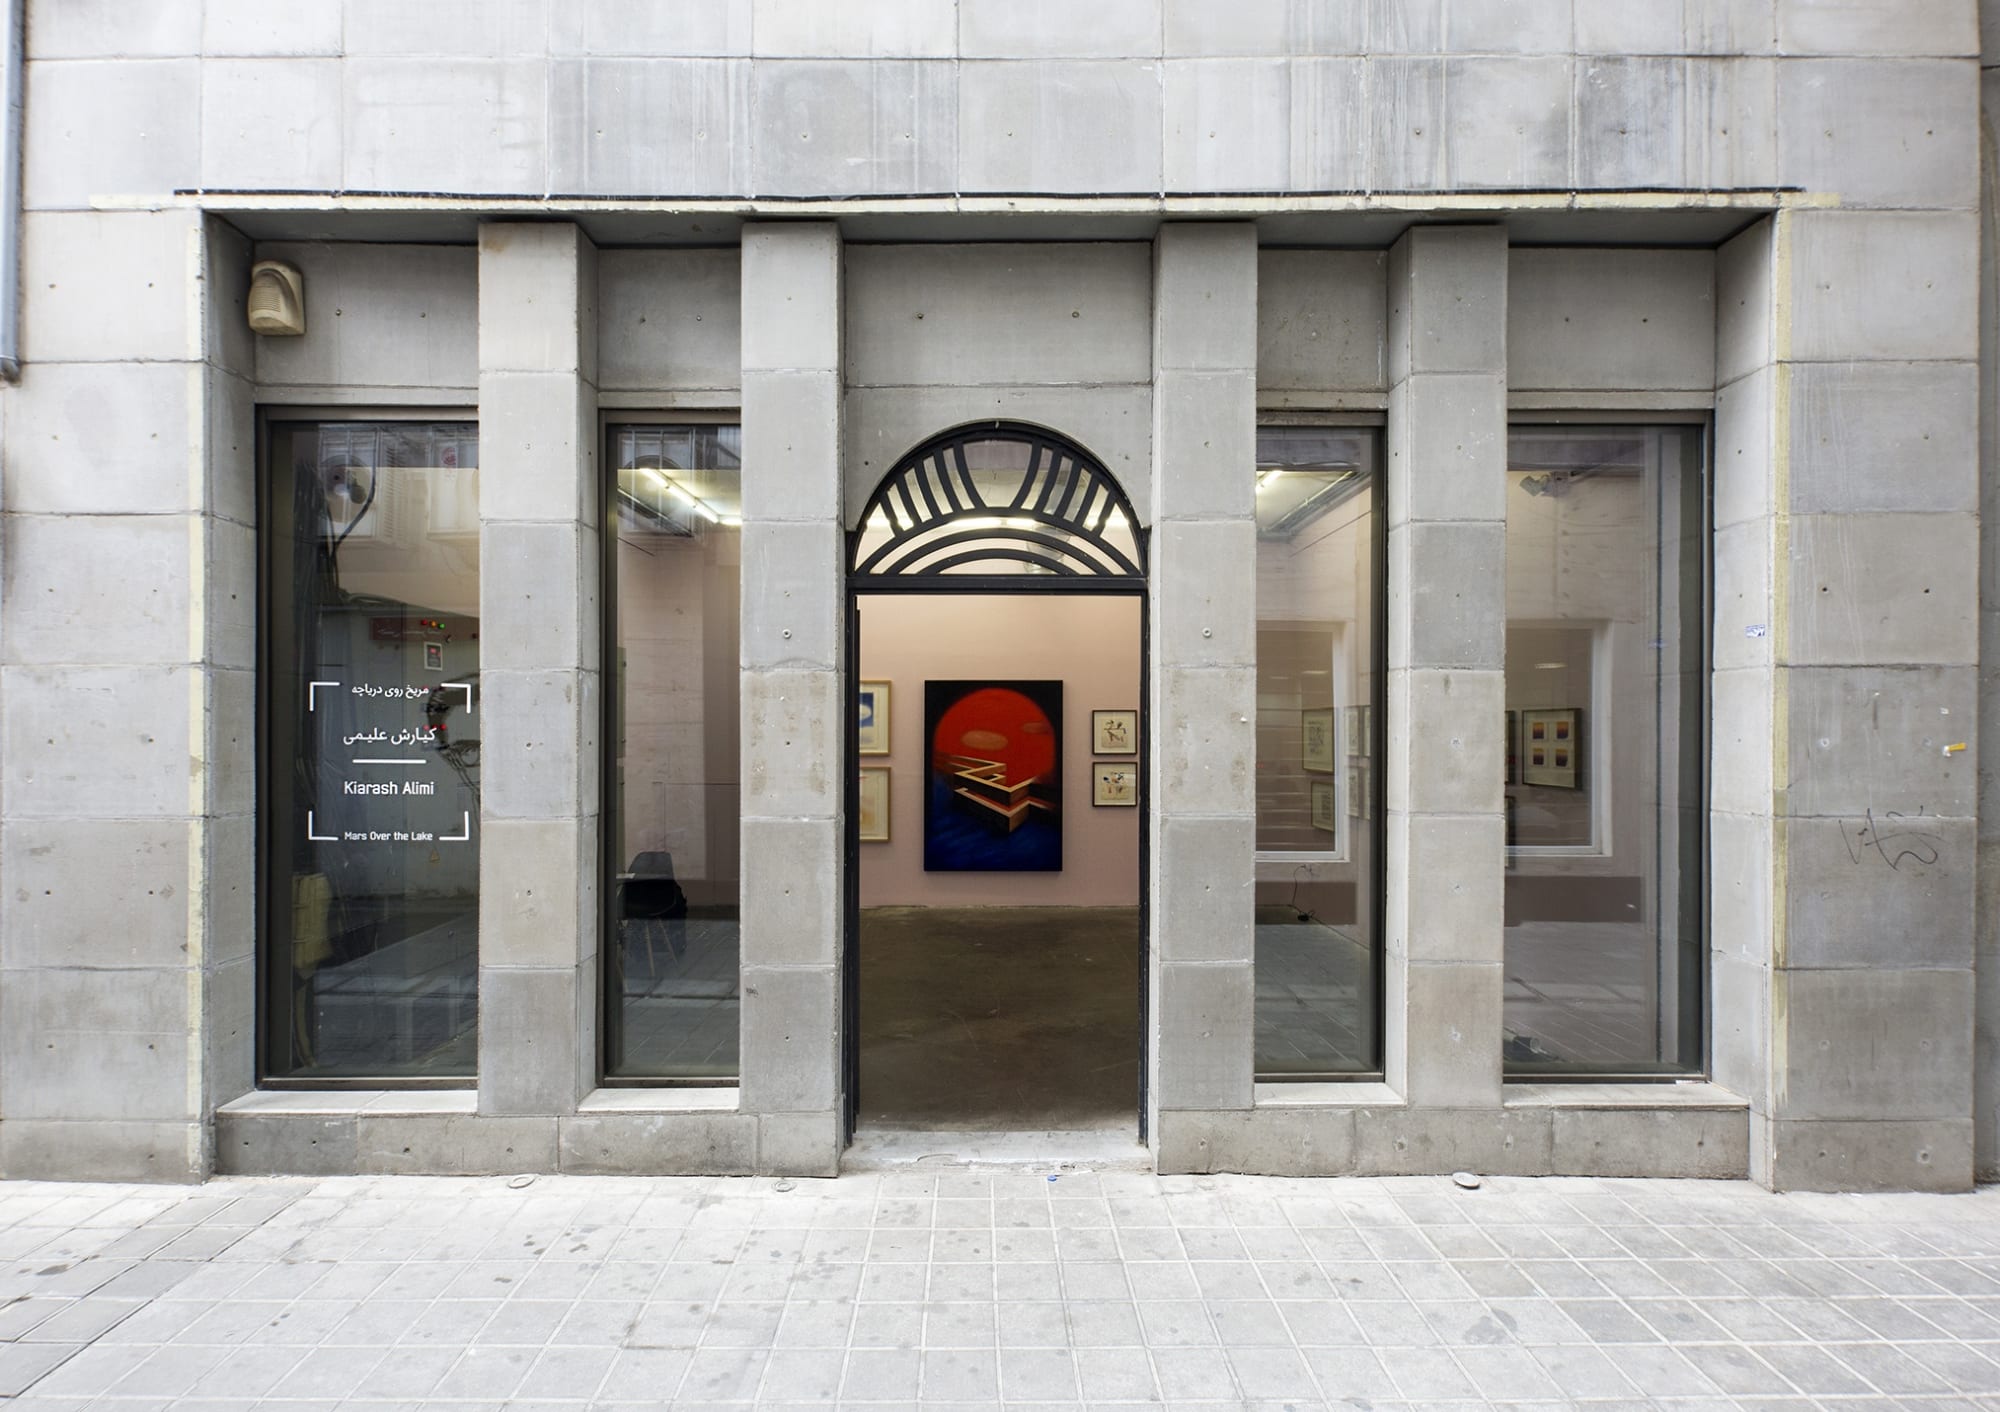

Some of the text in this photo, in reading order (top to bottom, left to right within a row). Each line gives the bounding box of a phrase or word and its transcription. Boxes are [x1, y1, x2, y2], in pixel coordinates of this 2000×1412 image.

[351, 683, 383, 697] دریاچه
[384, 687, 403, 698] روی
[343, 727, 437, 746] کیارش علیمی
[344, 780, 435, 795] Kiarash Alimi
[344, 831, 433, 841] Mars Over the Lake
